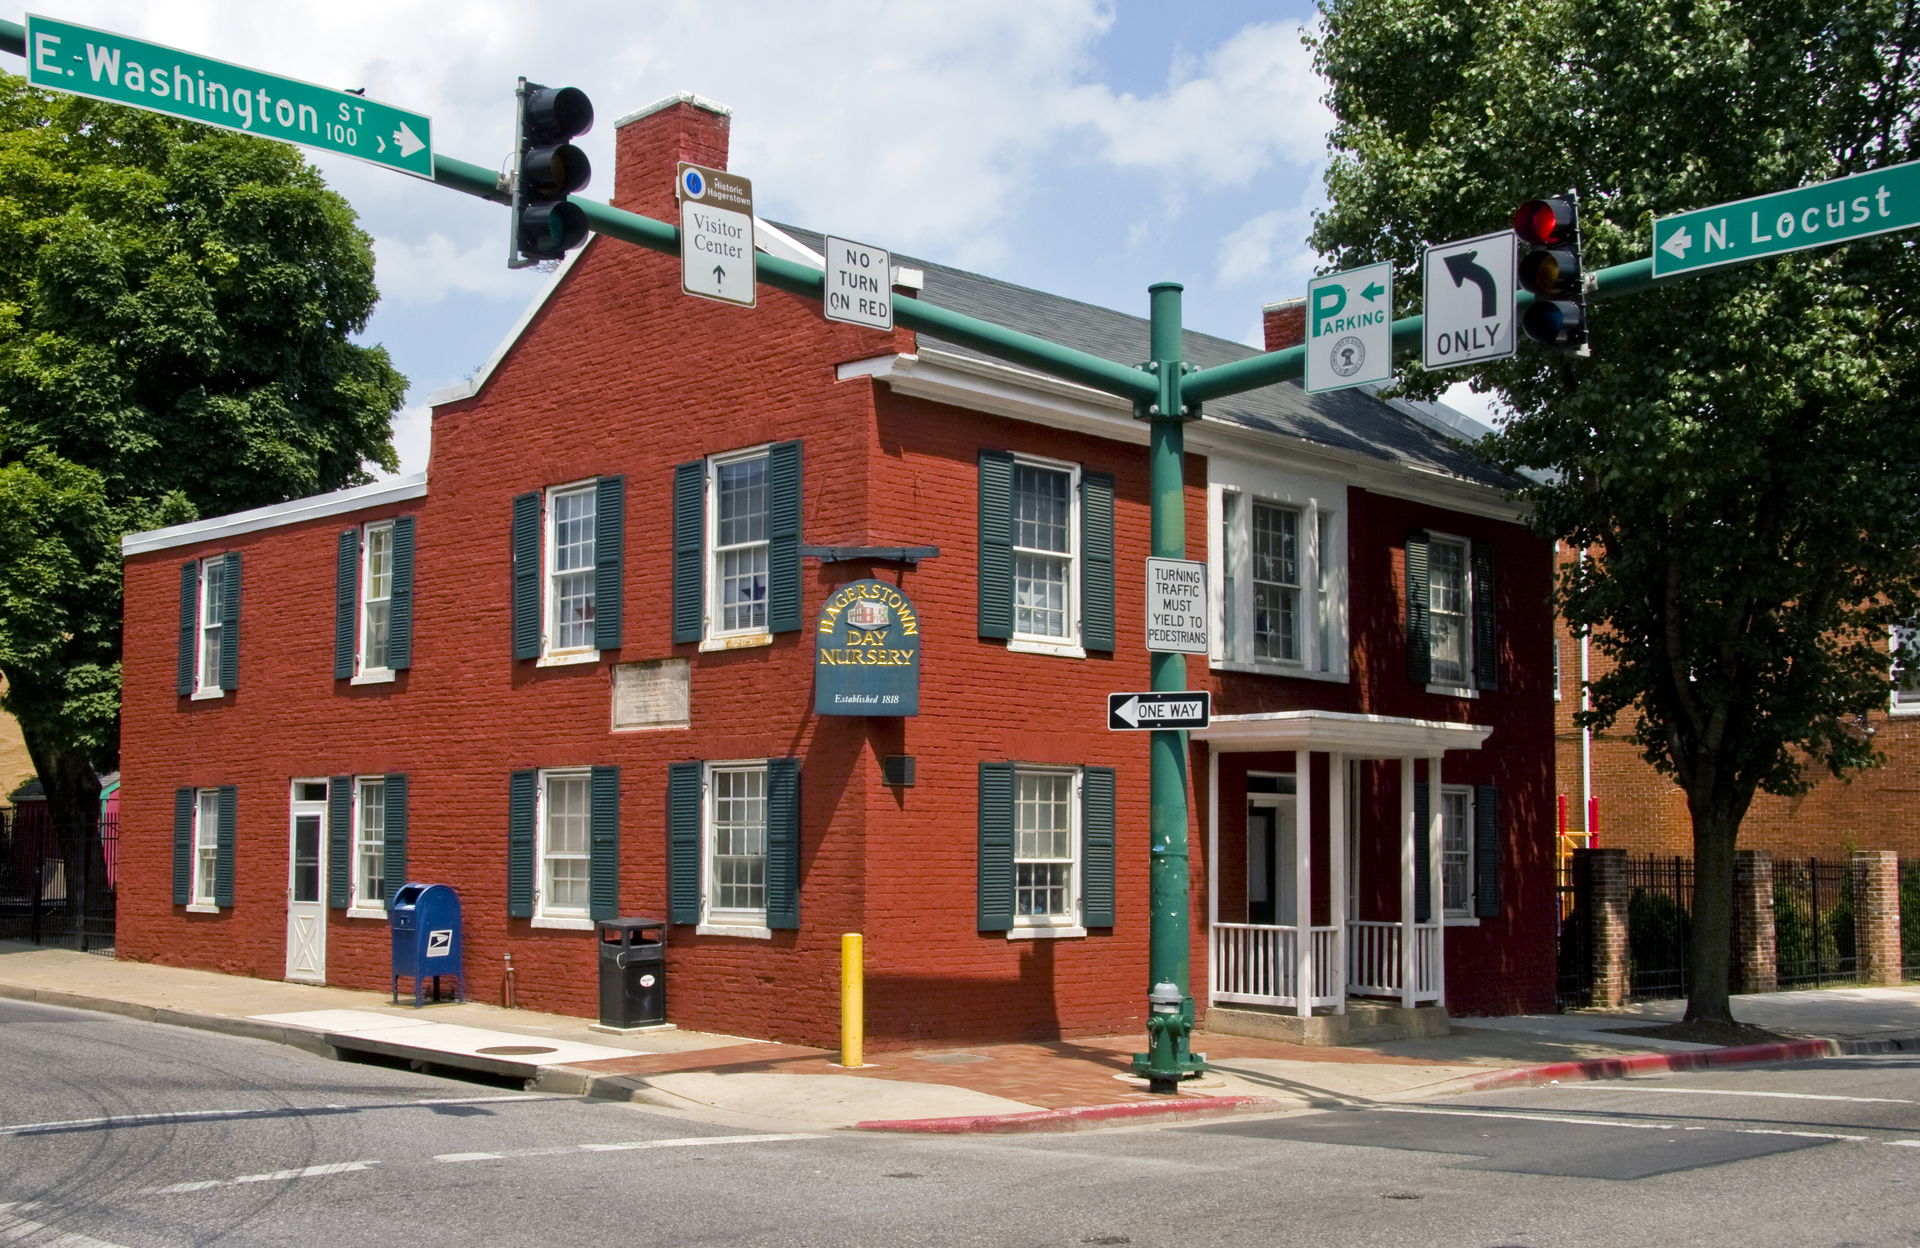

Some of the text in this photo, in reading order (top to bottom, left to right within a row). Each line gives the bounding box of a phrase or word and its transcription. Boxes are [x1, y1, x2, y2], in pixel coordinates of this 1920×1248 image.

[35, 32, 318, 134] E. Washington
[338, 102, 366, 125] ST
[326, 122, 357, 147] 100
[714, 178, 743, 195] Historic
[707, 187, 751, 206] Hagerstown
[694, 213, 743, 239] Visitor
[1704, 185, 1891, 253] N. Locust
[694, 234, 743, 258] Center
[846, 249, 869, 268] NO
[839, 270, 878, 293] TURN
[830, 292, 887, 318] ON RED
[1437, 323, 1501, 355] ONLY
[1155, 568, 1200, 583] TURNING
[1156, 583, 1199, 597] TRAFFIC
[819, 584, 919, 636] HAGERSTOWN
[1163, 599, 1192, 612] MUST
[1153, 613, 1202, 628] YIELD TO
[847, 631, 888, 645] DAY
[1149, 628, 1206, 644] PEDESTRIANS
[820, 649, 914, 665] NURSERY
[835, 694, 899, 704] Established 1818
[1138, 703, 1198, 718] ONE WAY
